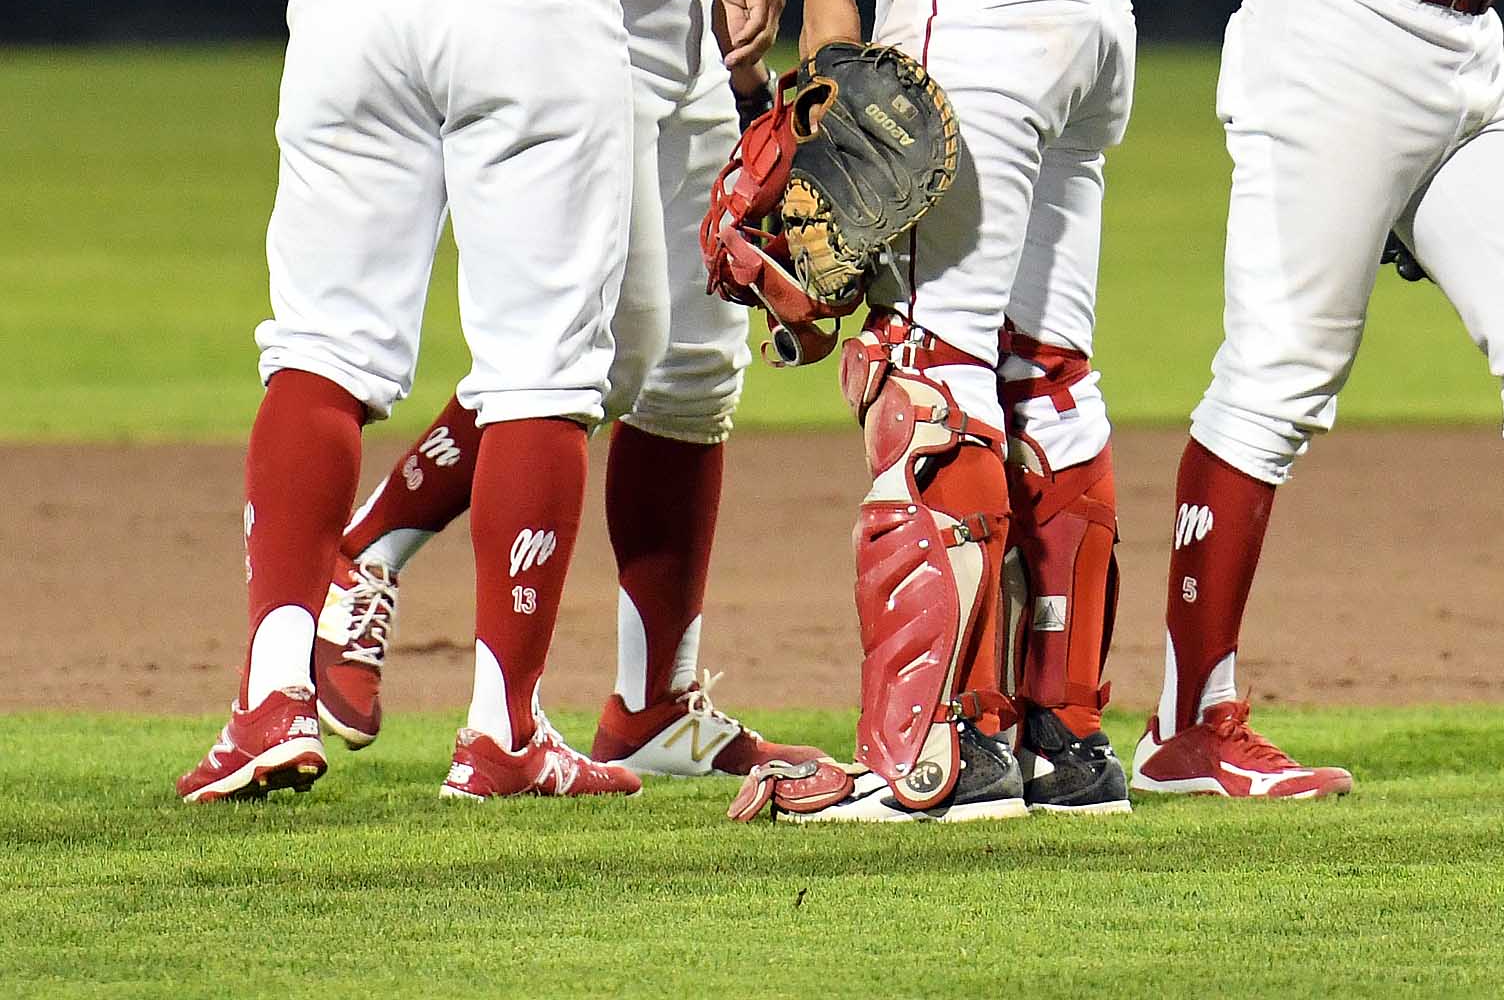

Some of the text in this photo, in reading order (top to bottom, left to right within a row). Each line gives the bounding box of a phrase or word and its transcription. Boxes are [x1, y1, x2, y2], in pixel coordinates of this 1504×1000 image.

[865, 103, 916, 146] A2000
[511, 585, 537, 615] 13
[1182, 575, 1197, 603] 5
